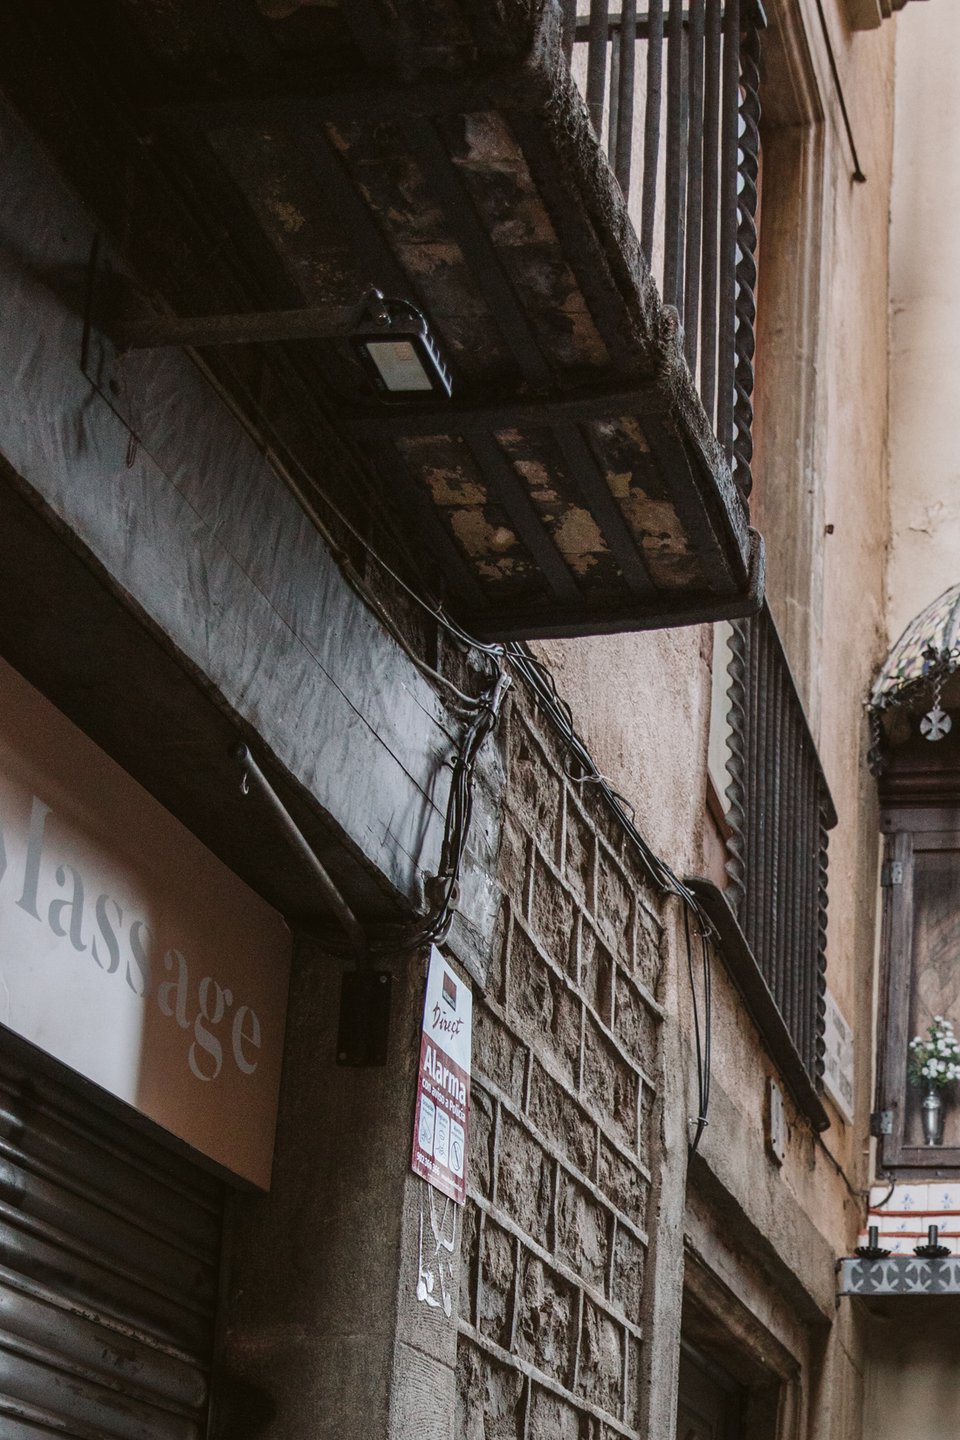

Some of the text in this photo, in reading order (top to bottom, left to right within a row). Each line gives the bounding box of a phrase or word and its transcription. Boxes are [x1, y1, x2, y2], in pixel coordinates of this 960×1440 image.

[432, 1001, 464, 1040] Direct
[421, 1078, 432, 1093] con
[423, 1045, 467, 1107] Alarma
